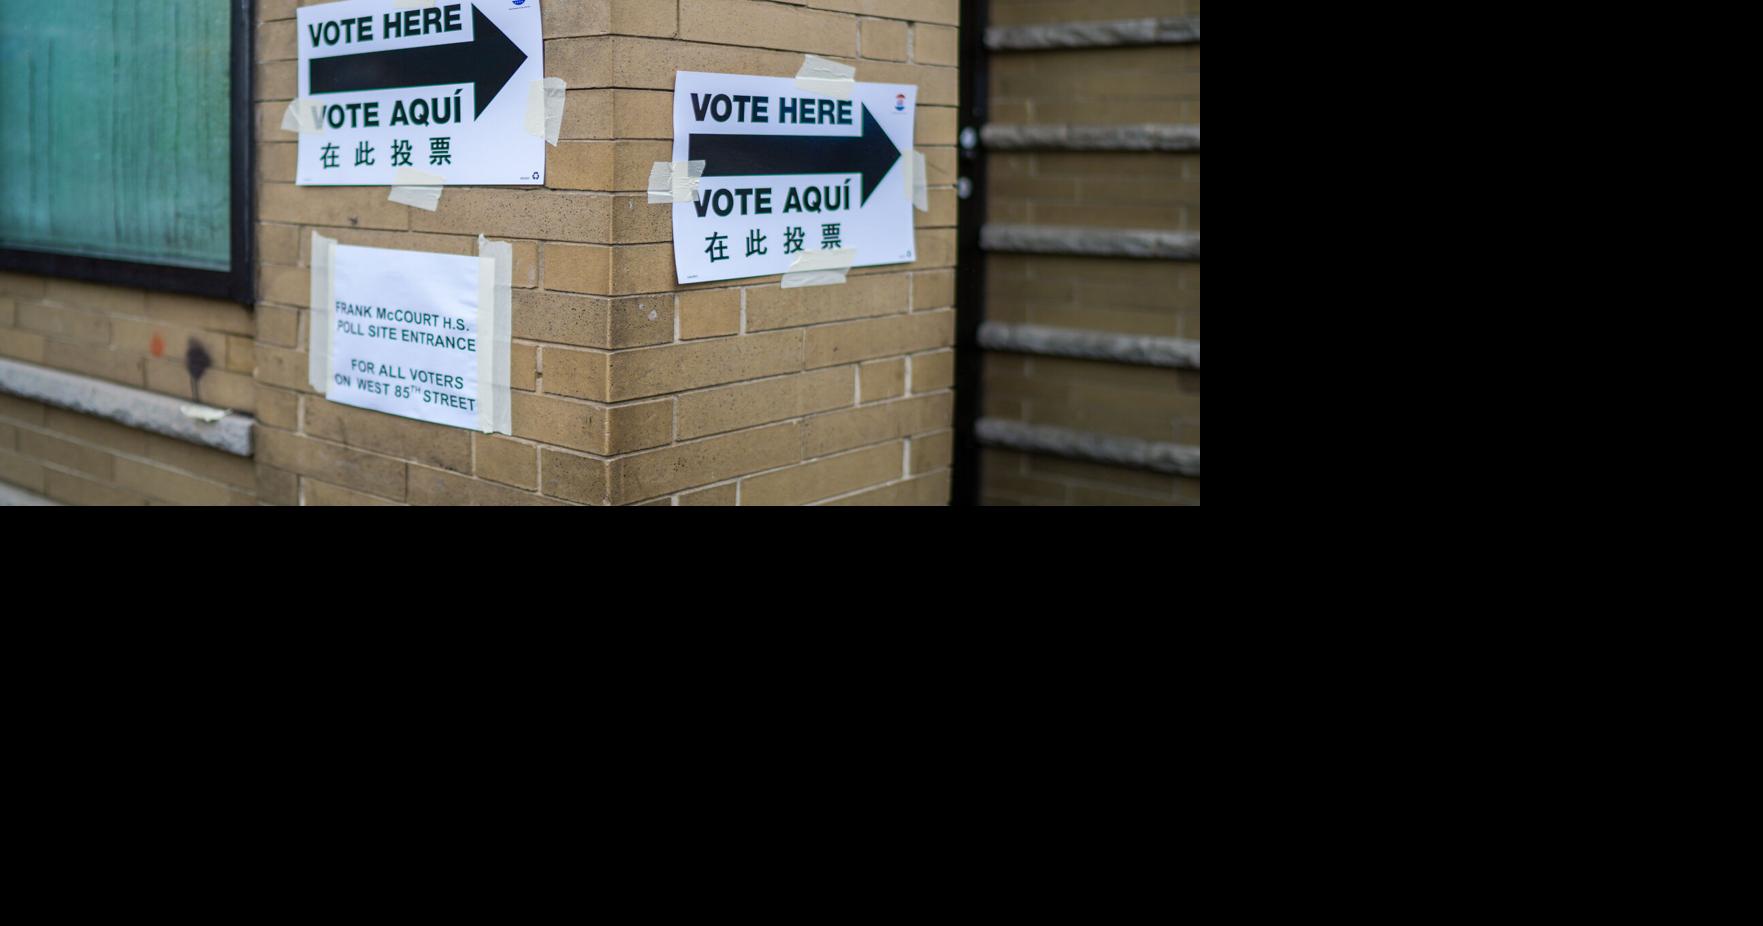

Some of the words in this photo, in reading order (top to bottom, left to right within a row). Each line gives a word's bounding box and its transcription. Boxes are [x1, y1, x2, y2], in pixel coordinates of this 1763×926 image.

[308, 15, 374, 48] VOTE
[383, 3, 462, 40] HERE
[311, 101, 380, 130] VOTE
[389, 88, 463, 127] AQUÍ
[690, 92, 769, 123] VOTE
[778, 96, 853, 126] HERE
[319, 136, 452, 169] 在此投票
[690, 187, 772, 218] VOTE
[782, 178, 851, 215] AQUÍ
[704, 222, 842, 264] 在此投票
[335, 301, 372, 319] FRANK
[376, 307, 439, 326] McCOURT
[443, 317, 470, 332] H.S.
[337, 320, 364, 337] POLL
[368, 325, 397, 341] SITE
[401, 329, 477, 352] ENTRANCE
[334, 373, 352, 387] ON
[357, 379, 390, 396] WEST
[423, 390, 476, 411] STREET
[351, 359, 375, 375] FOR
[379, 364, 406, 380] ALL
[409, 368, 464, 390] VOTERS
